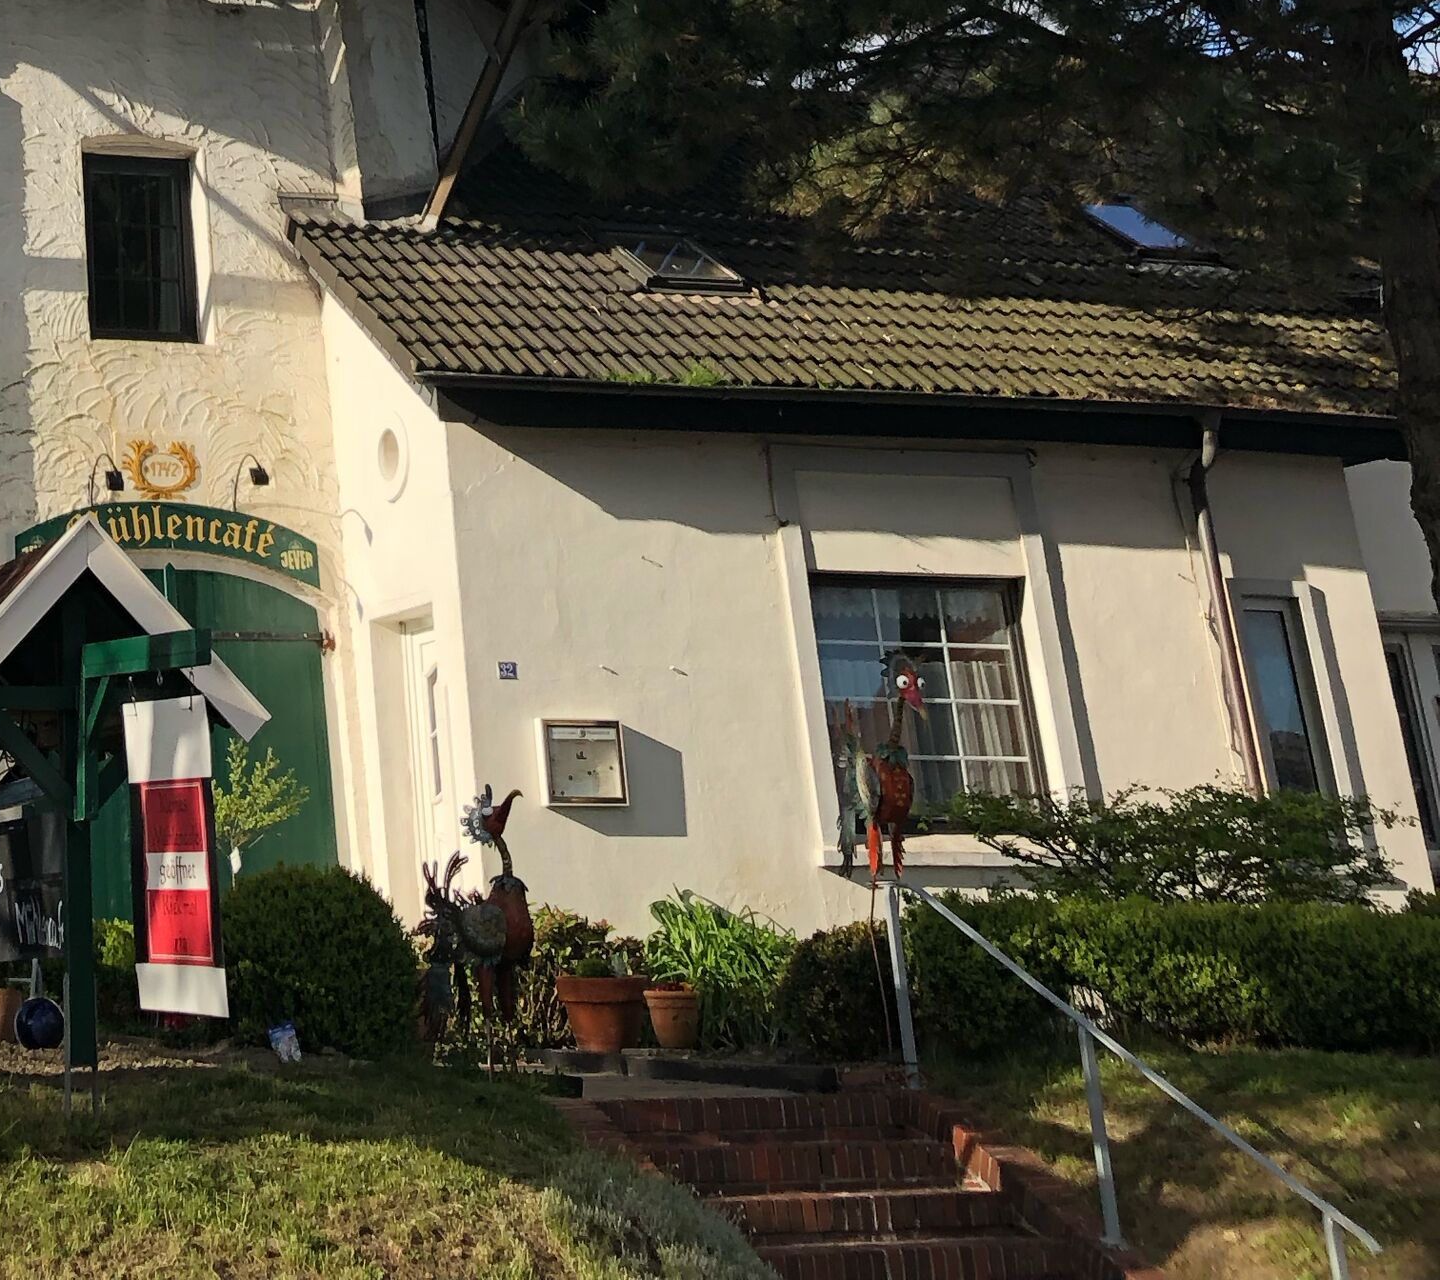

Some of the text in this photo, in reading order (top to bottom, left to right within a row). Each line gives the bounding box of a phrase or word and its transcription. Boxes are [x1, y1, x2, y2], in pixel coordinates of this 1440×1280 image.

[66, 505, 277, 559] ühlencafé
[280, 550, 314, 571] JEVER
[500, 663, 515, 676] 32
[159, 855, 197, 886] geöffnet
